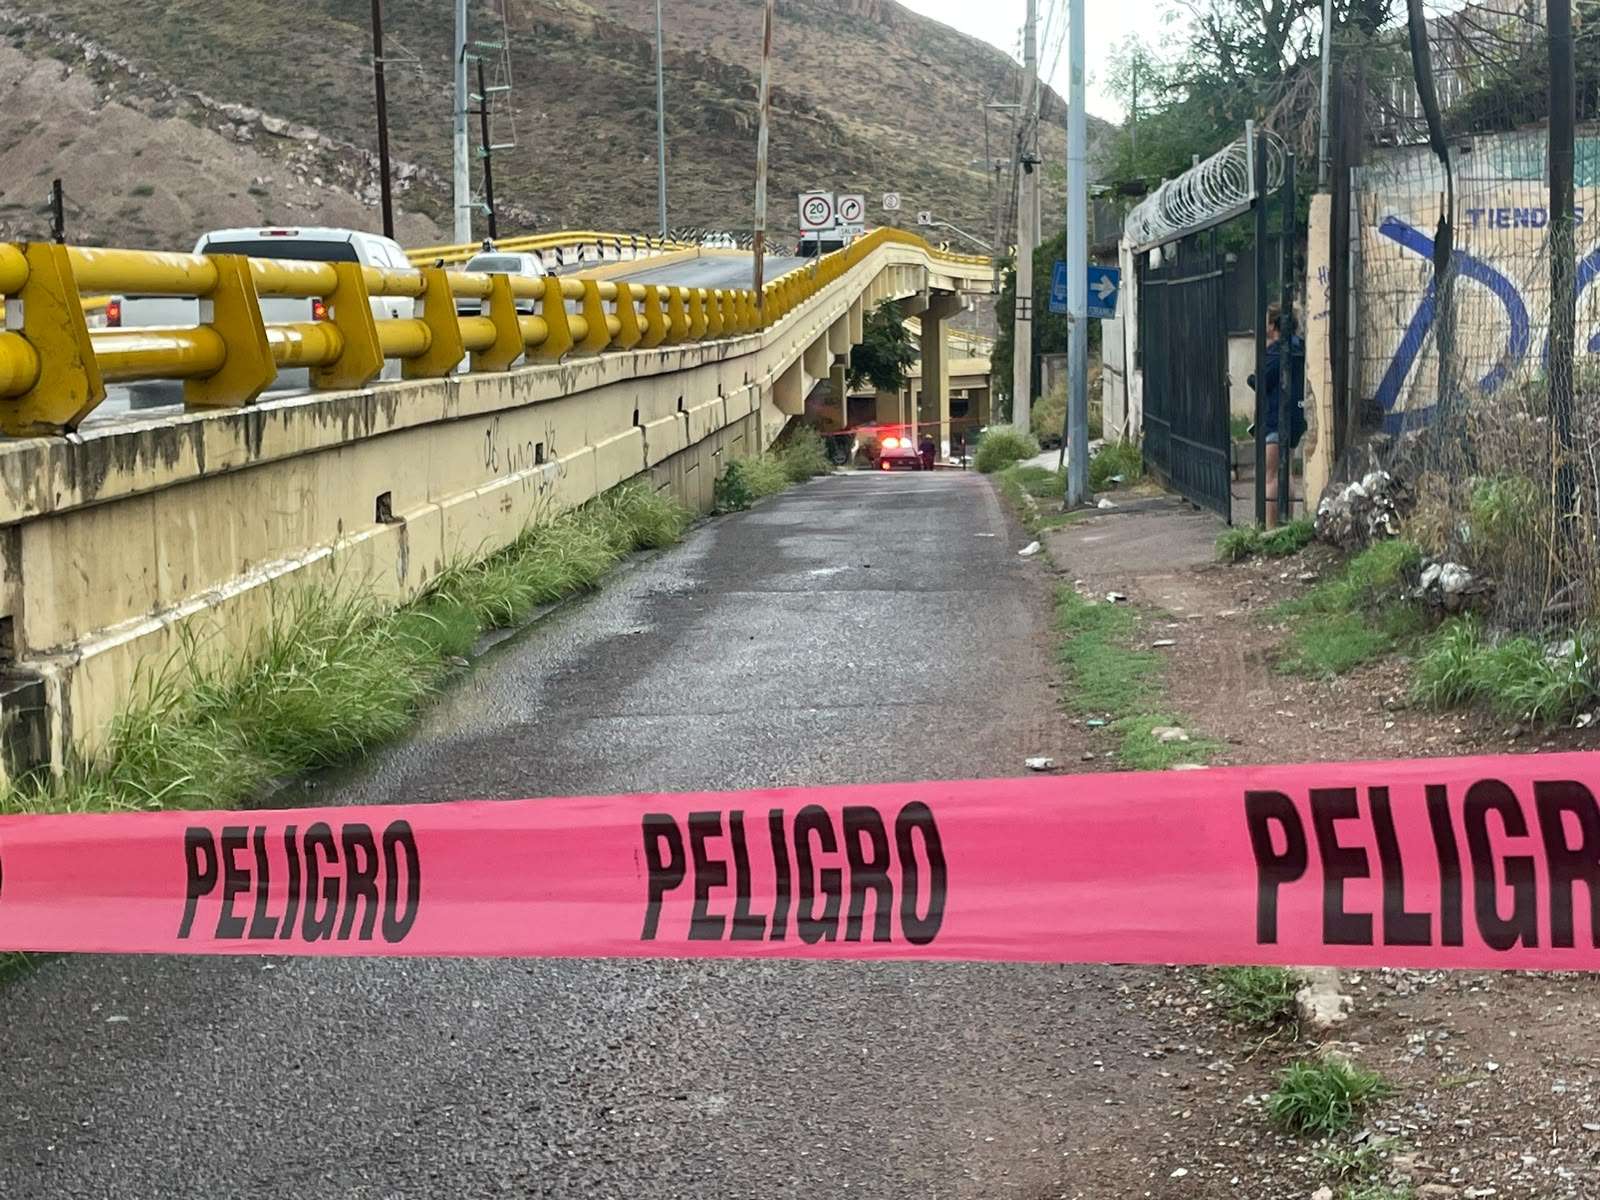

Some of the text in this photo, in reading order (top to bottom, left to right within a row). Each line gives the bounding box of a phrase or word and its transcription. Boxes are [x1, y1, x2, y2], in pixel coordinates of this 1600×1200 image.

[809, 203, 824, 215] 20
[1465, 207, 1584, 230] TIENDS
[177, 819, 421, 943] PELIGRO
[640, 801, 948, 945] PELIGRO
